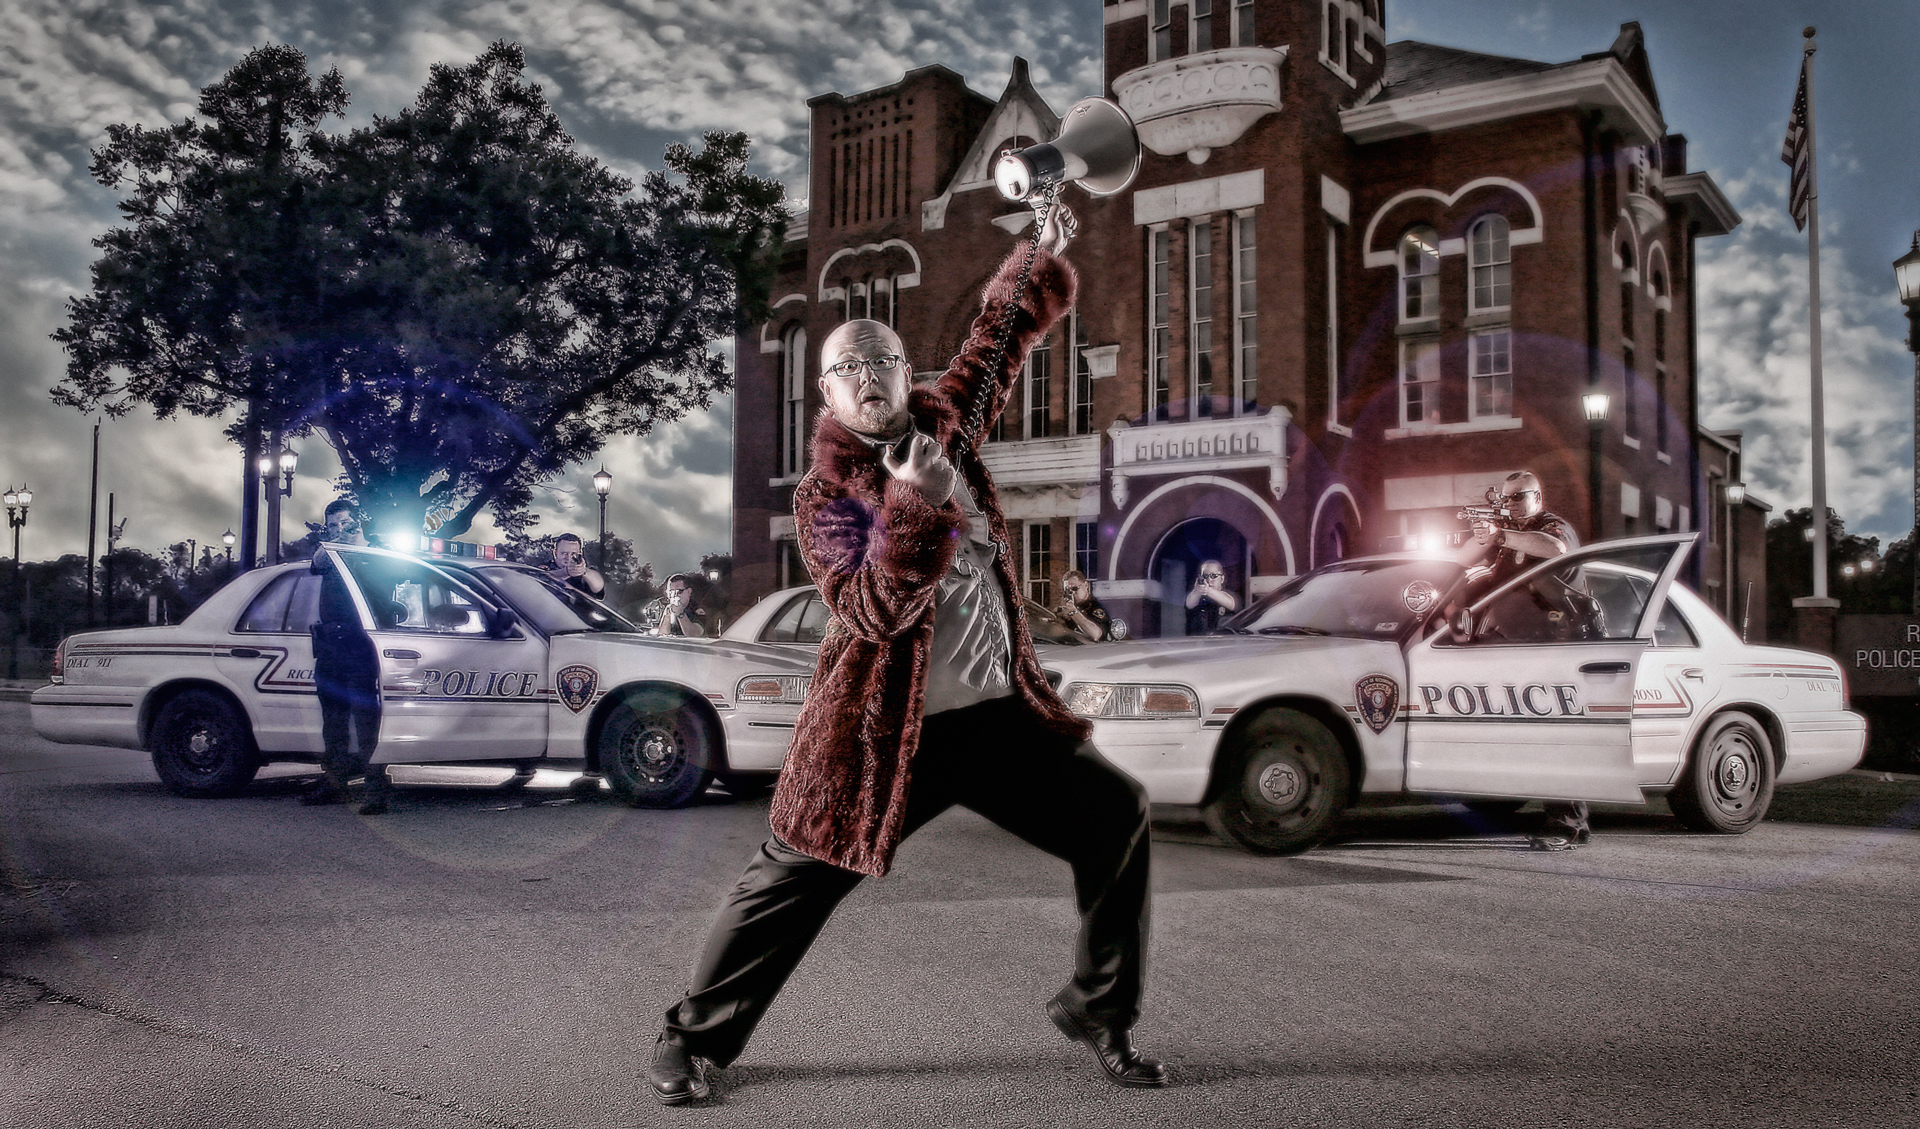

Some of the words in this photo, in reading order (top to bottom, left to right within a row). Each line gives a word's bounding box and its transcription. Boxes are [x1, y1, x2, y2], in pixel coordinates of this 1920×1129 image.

[66, 658, 90, 668] DIAL
[96, 658, 112, 668] 911
[1856, 649, 1920, 668] POLICE
[417, 668, 538, 697] POLICE
[1806, 681, 1827, 692] DIAL
[1417, 684, 1585, 716] POLICE
